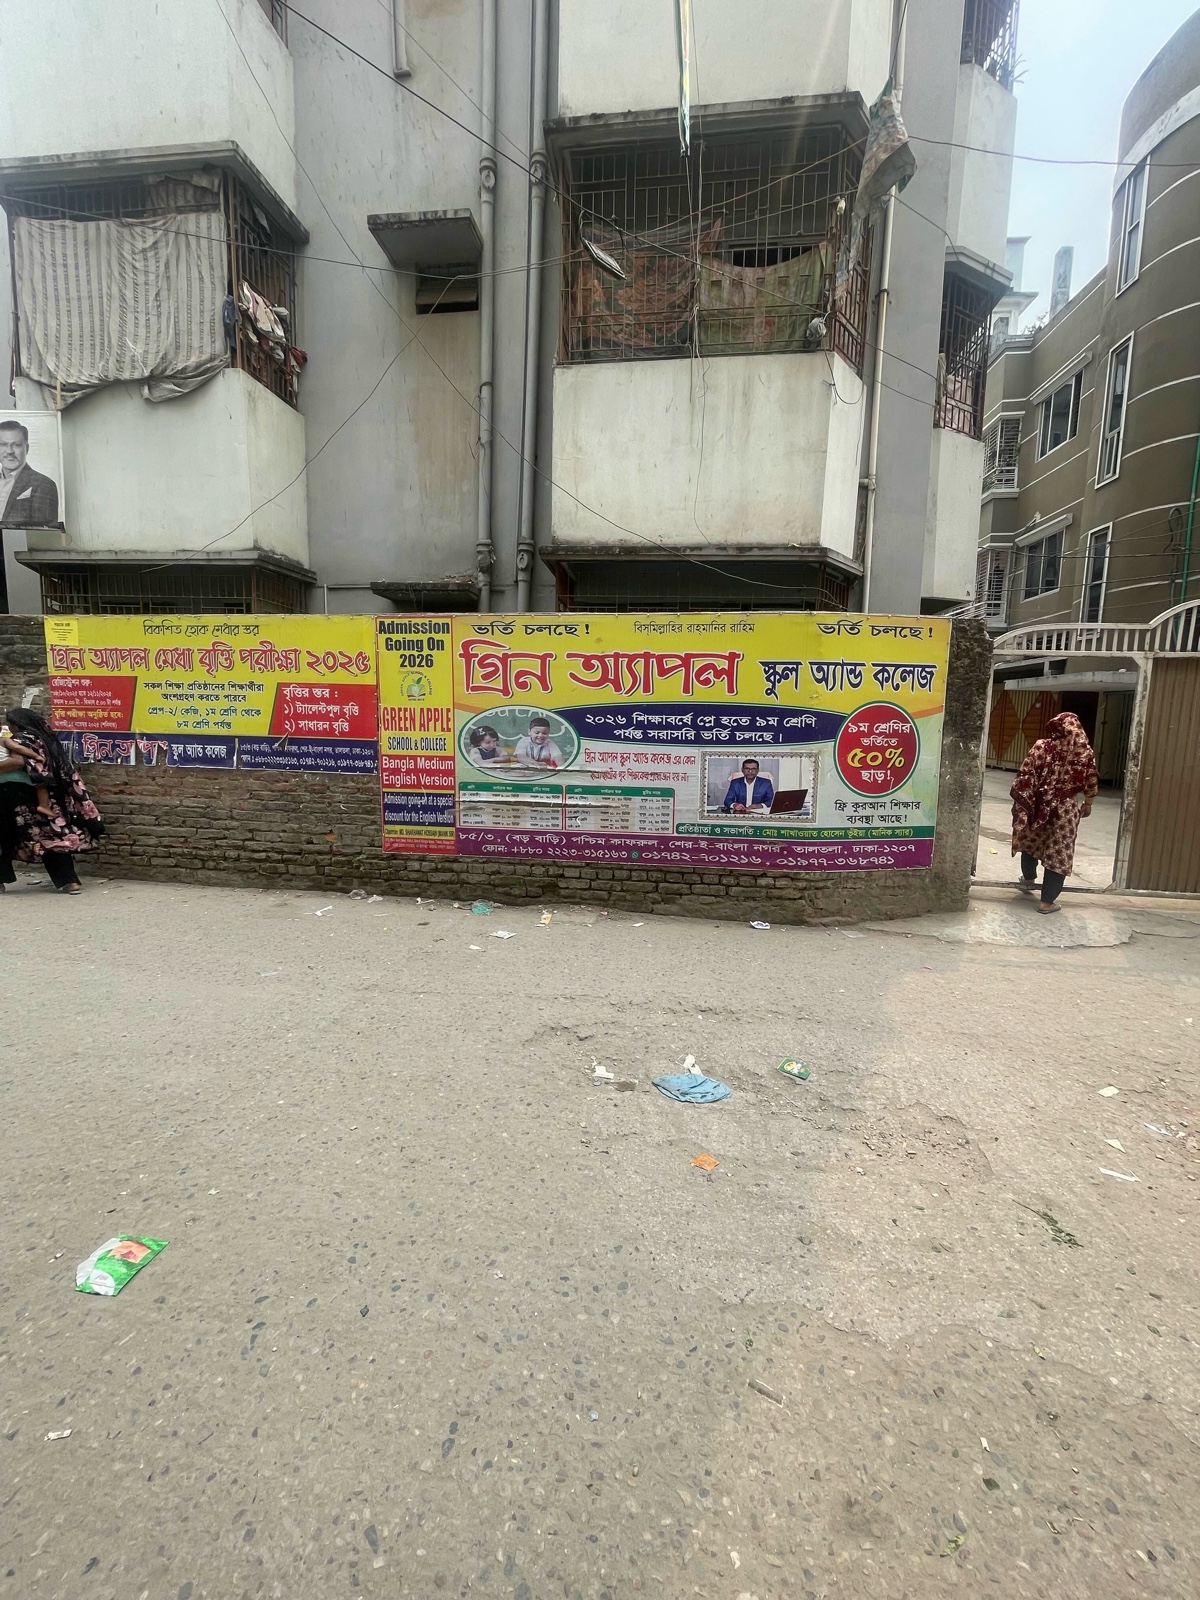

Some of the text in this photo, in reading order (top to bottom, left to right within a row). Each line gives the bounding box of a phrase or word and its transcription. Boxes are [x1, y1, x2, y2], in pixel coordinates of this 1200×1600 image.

[143, 620, 259, 637] বিকশিত হোক মেধার স্তর
[379, 620, 450, 634] Admission
[471, 621, 580, 637] ভর্তি চলছে
[730, 620, 755, 633] রাহিম
[817, 620, 924, 640] ভর্তি চলছে
[385, 637, 444, 652] Going On
[50, 640, 370, 678] গ্রিন অ্যাপল মেধা বৃত্তি পরীক্ষা ২০২৫
[400, 654, 433, 668] 2026
[458, 638, 556, 698] গ্রিন
[566, 651, 744, 697] অ্যাপল
[758, 660, 803, 701] স্কুল
[808, 658, 867, 692] অ্যান্ড
[872, 662, 938, 693] কলেজ
[144, 680, 264, 692] সকল শিক্ষা প্রতিষ্ঠানের শিক্ষার্থীরা
[282, 684, 330, 701] বৃত্তির স্তর
[161, 693, 246, 703] অংশগ্রহণ করতে পারবে
[205, 708, 216, 716] ১ম
[220, 706, 238, 717] শ্রেণি
[240, 708, 262, 716] থেকে
[284, 701, 359, 719] ১) ট্যালেন্টপুল বৃত্তি
[177, 718, 232, 729] ৮ম শ্রেণি পর্যন্ত
[382, 706, 451, 732] GREEN APPLE
[585, 712, 817, 728] ২০২৬ শিক্ষাবর্ষে প্লে হতে ৯ম শ্রেণি
[284, 718, 349, 736] ২) সাধারন বৃত্তি
[614, 726, 774, 743] পর্যন্ত সরাসরি ভর্তি চলছে
[848, 720, 912, 734] ৯ম শ্রেণির
[388, 737, 446, 751] SCHOOL & COLLEGE
[860, 735, 898, 746] ভর্তিতে
[171, 744, 184, 761] স্কুল
[204, 745, 227, 759] কলেজ
[847, 748, 905, 768] ৫০%
[382, 756, 454, 771] Bangla Medium
[383, 772, 454, 787] English Version
[385, 793, 407, 804] Admission
[408, 794, 420, 808] going
[428, 795, 433, 805] at
[437, 795, 453, 808] special
[834, 800, 921, 813] ফ্রি কুরআন শিক্ষার
[385, 810, 404, 821] discount
[420, 811, 436, 825] English
[437, 811, 454, 823] Version
[846, 815, 874, 825] ব্যবস্থা
[723, 826, 754, 835] সভাপতি
[820, 830, 845, 838] হোসেন
[506, 833, 530, 843] (বড়
[534, 833, 566, 845] বাড়ি)
[571, 835, 606, 845] পশ্চিম
[669, 840, 748, 851] শের-ই-বাংলা
[852, 844, 915, 853] ঢাকা-১২০৭
[511, 846, 543, 854] +৮৮০
[547, 847, 628, 858] ২২২৩-৩১৫১৬৩
[777, 856, 895, 866] ০১৯৭৭-৩৬৮৭৪১
